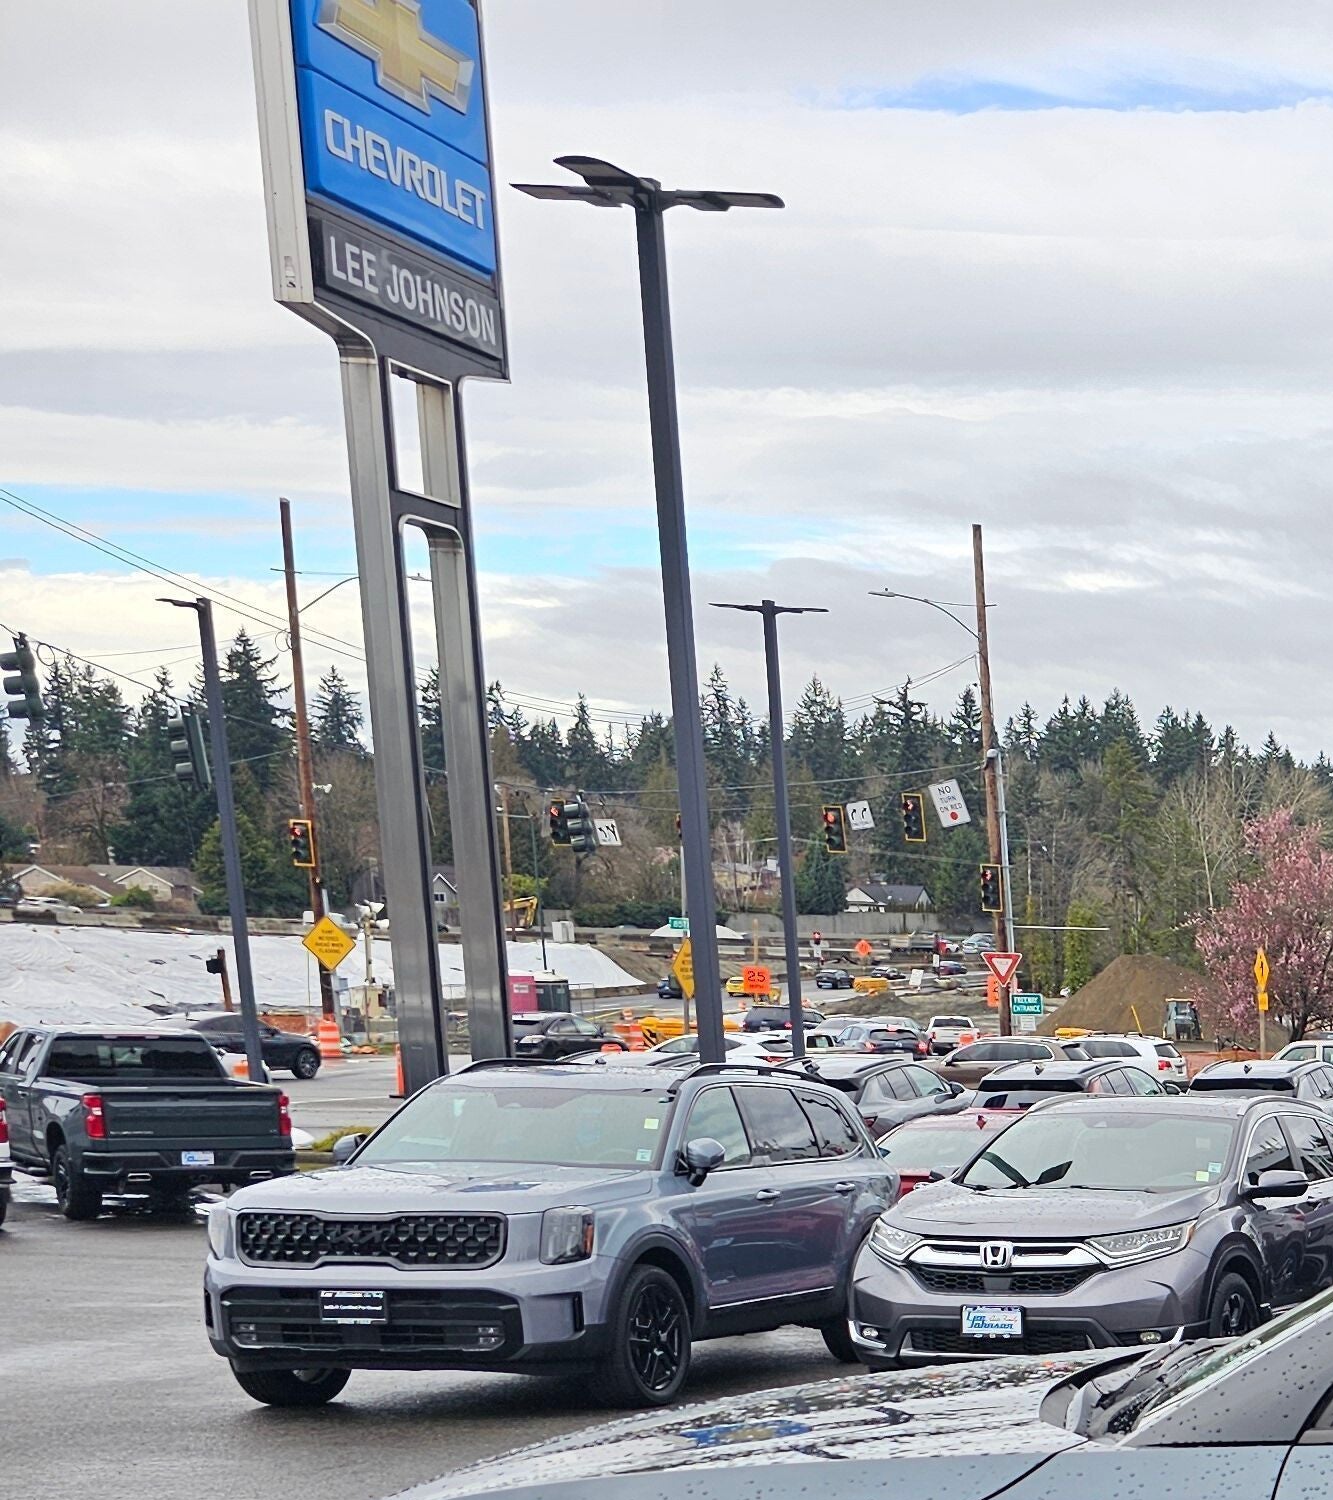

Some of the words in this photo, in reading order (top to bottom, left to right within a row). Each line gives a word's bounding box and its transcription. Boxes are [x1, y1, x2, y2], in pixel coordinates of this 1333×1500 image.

[324, 109, 486, 230] CHEVROLET
[329, 235, 379, 295] LEE
[386, 263, 497, 345] JOHNSON
[938, 786, 951, 795] NO
[950, 803, 962, 811] RED
[748, 971, 765, 982] 25
